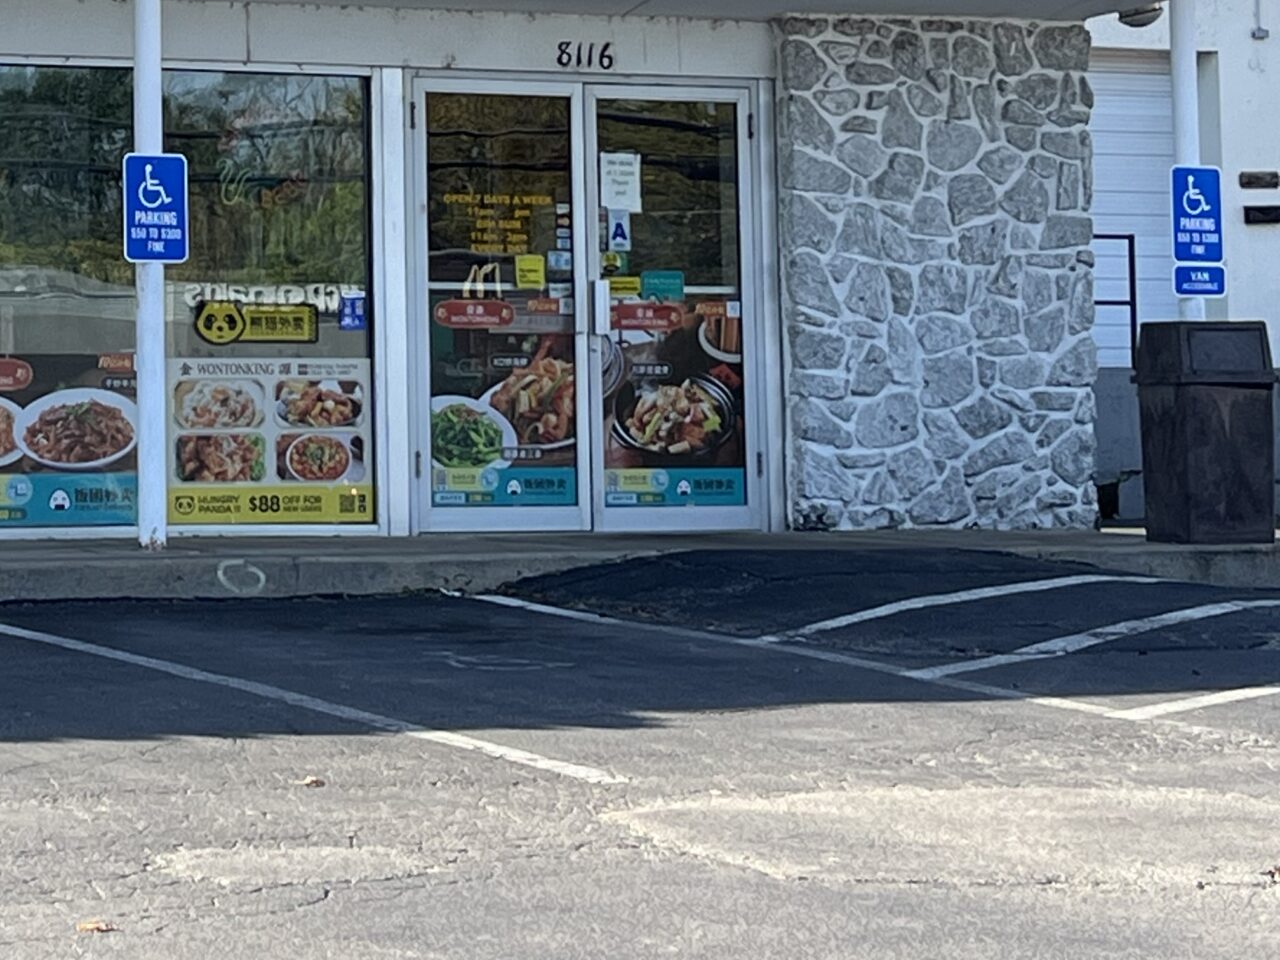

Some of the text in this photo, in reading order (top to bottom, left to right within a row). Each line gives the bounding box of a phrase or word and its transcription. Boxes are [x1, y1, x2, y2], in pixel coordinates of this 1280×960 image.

[556, 40, 614, 70] 8116
[134, 210, 177, 226] PARKING
[1179, 216, 1216, 232] PARKING
[148, 227, 159, 239] TO
[612, 222, 628, 240] A
[147, 240, 165, 253] FINE
[1190, 271, 1210, 282] VAN
[196, 363, 275, 376] WONTONKING
[249, 495, 280, 513] $88
